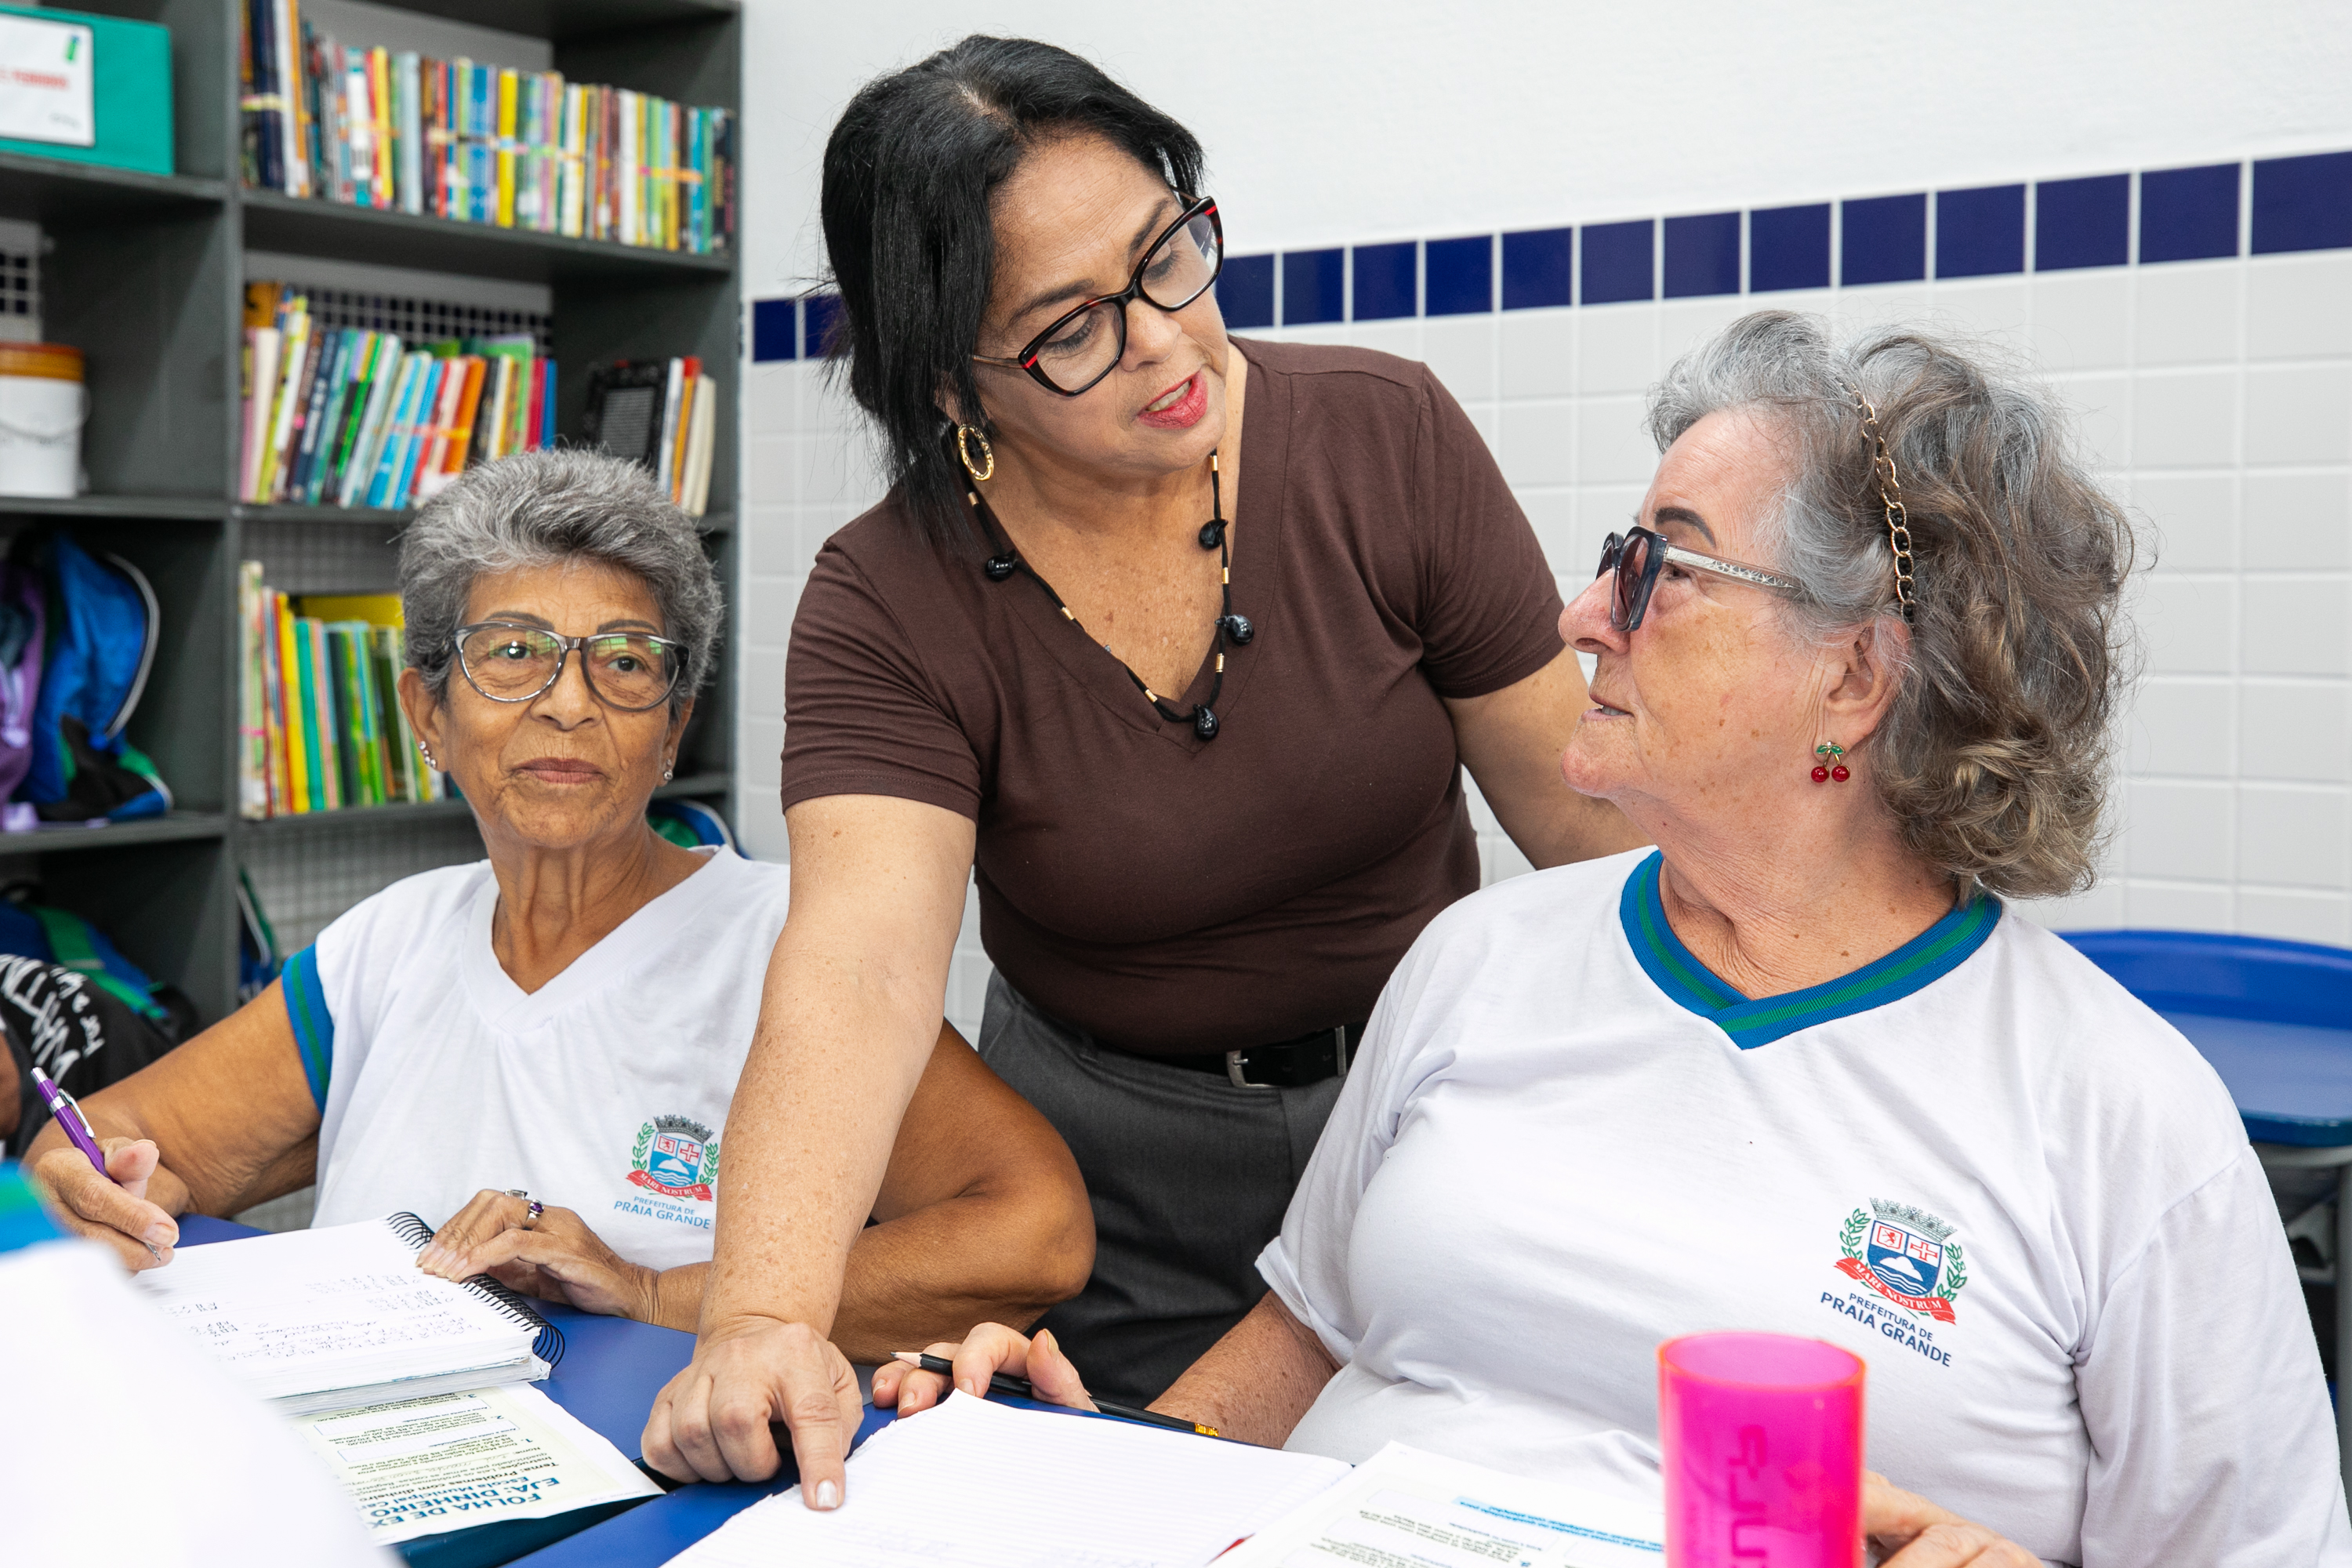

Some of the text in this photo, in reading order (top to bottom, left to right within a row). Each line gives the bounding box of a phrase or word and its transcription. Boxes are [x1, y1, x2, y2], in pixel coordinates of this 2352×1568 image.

[639, 1173, 703, 1196] MARE NOSTRUM
[614, 1200, 711, 1229] PRAIA GRANDE
[633, 1196, 695, 1216] PREFEITURA DE
[1853, 1261, 1943, 1311] MARE NOSTRUM
[1849, 1293, 1934, 1342] PREFEITURA DE
[1820, 1291, 1952, 1367] PRAIA GRANDE
[520, 1461, 559, 1472] Tema:
[448, 1471, 517, 1485] Problemas
[477, 1475, 529, 1488] Escola
[359, 1488, 415, 1501] dinheiro
[371, 1477, 559, 1516] EJA: DINHEIRO
[393, 1486, 474, 1504] Municipal
[453, 1493, 541, 1510] FOLHA
[417, 1507, 447, 1518] DE
